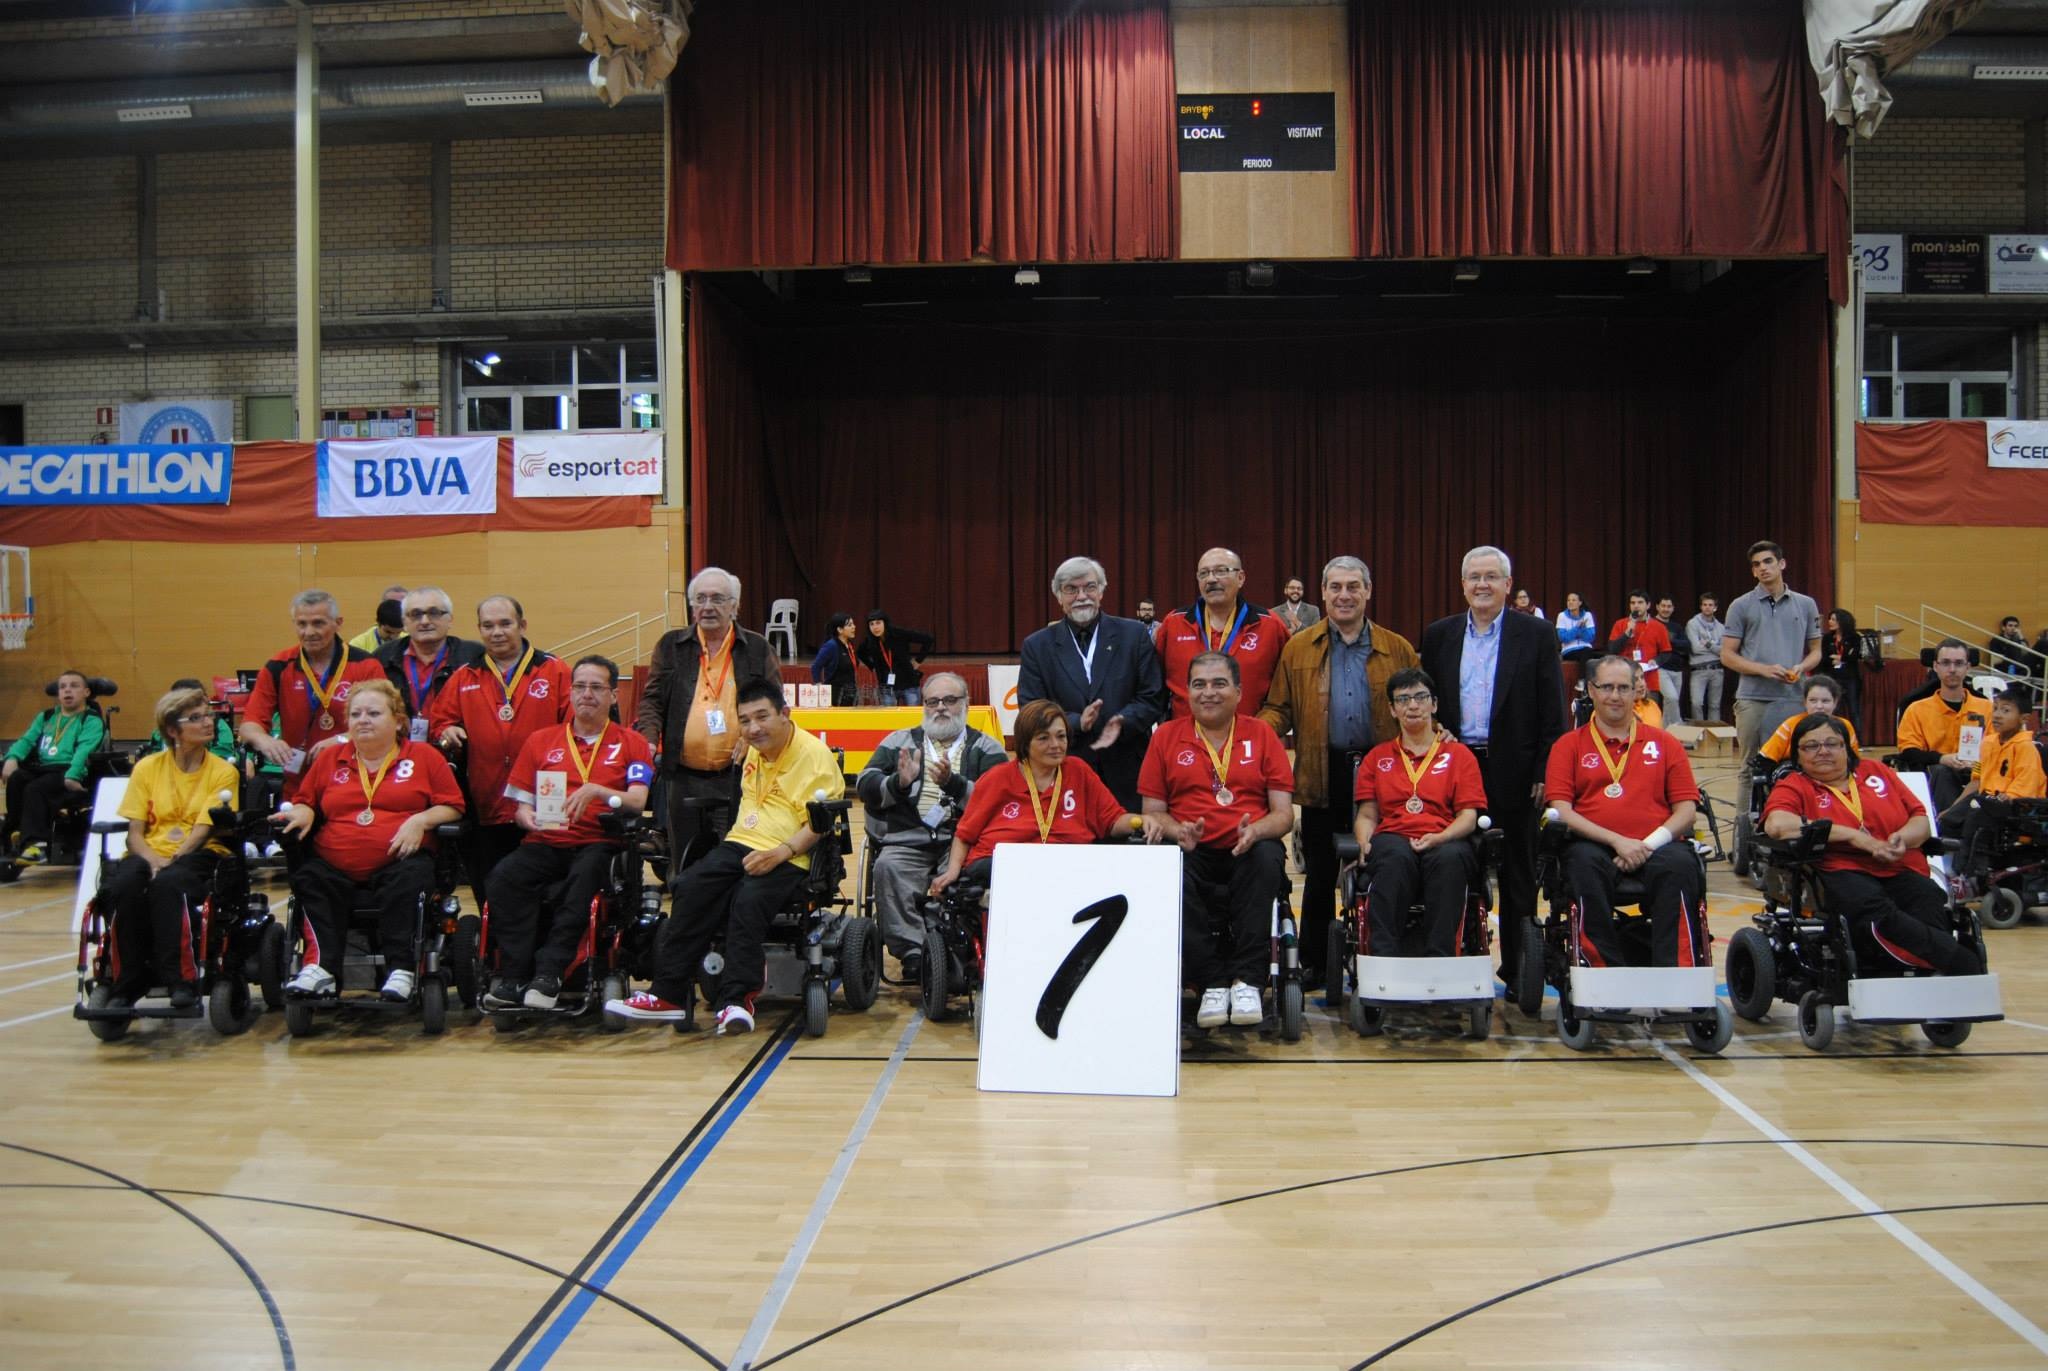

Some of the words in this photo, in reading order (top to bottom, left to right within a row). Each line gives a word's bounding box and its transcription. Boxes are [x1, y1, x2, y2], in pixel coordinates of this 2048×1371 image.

[1184, 128, 1225, 139] LOCAL
[1287, 127, 1323, 138] VISITANT
[1242, 158, 1272, 168] PERIODO
[355, 457, 470, 497] BBVA
[548, 457, 657, 481] esportcat
[608, 743, 621, 761] 7
[1242, 740, 1252, 758] 1
[1642, 740, 1659, 759] 4
[396, 759, 415, 778] 8
[1433, 752, 1451, 769] 2
[627, 763, 644, 779] C
[1865, 775, 1885, 794] 9
[1063, 789, 1076, 811] 6
[1035, 894, 1128, 1040] 1
